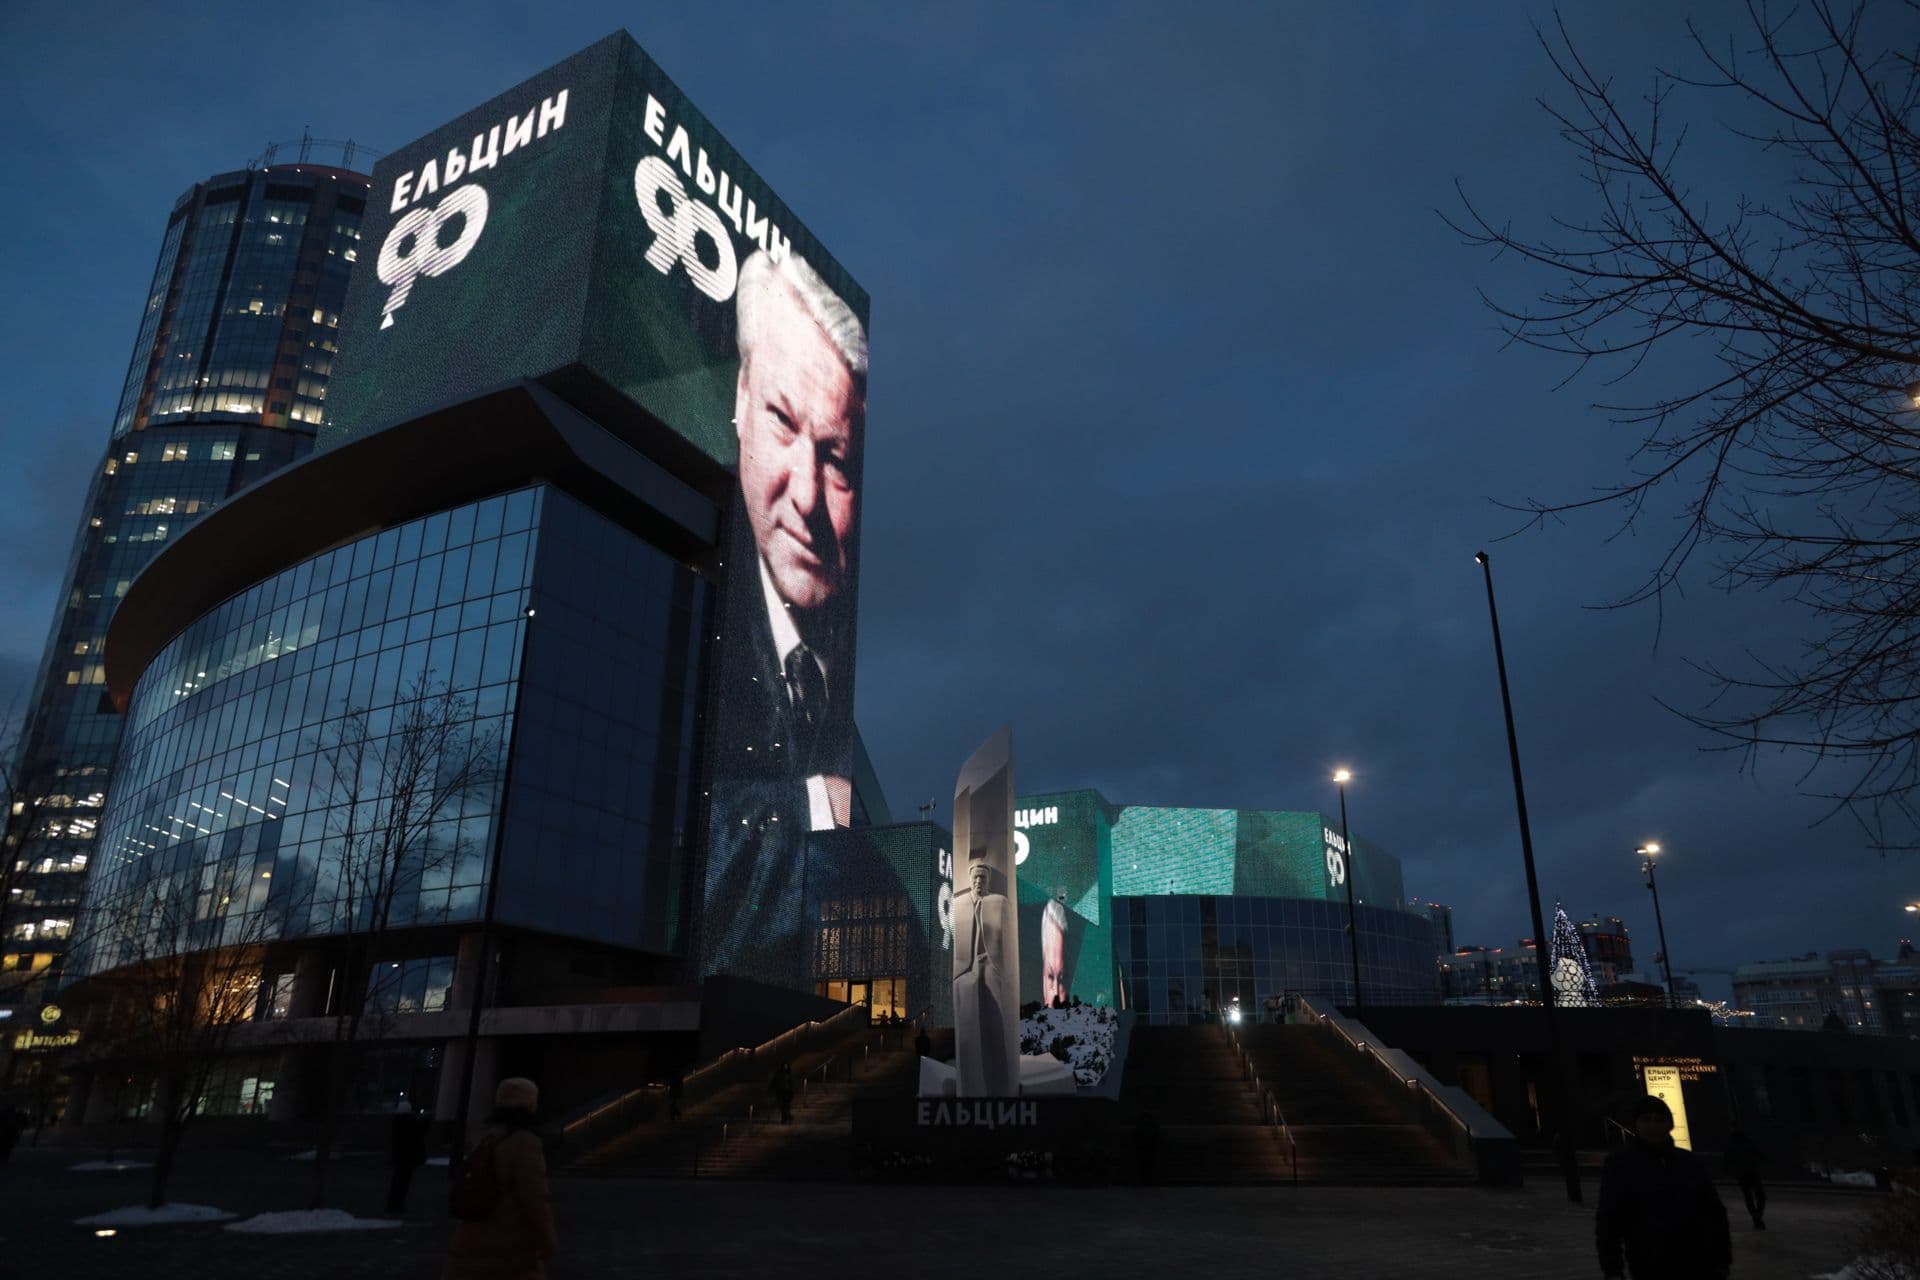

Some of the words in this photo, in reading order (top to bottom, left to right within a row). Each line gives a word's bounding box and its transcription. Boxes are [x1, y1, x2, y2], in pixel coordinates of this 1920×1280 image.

[390, 88, 569, 214] ЕЛЬЦИН
[644, 93, 791, 264] ЕЛЬЦИН
[376, 184, 489, 330] 90
[634, 155, 738, 302] 90
[1014, 806, 1058, 829] ЦИН
[1326, 847, 1345, 887] 90
[917, 1101, 1038, 1130] ЕЛЬЦИН
